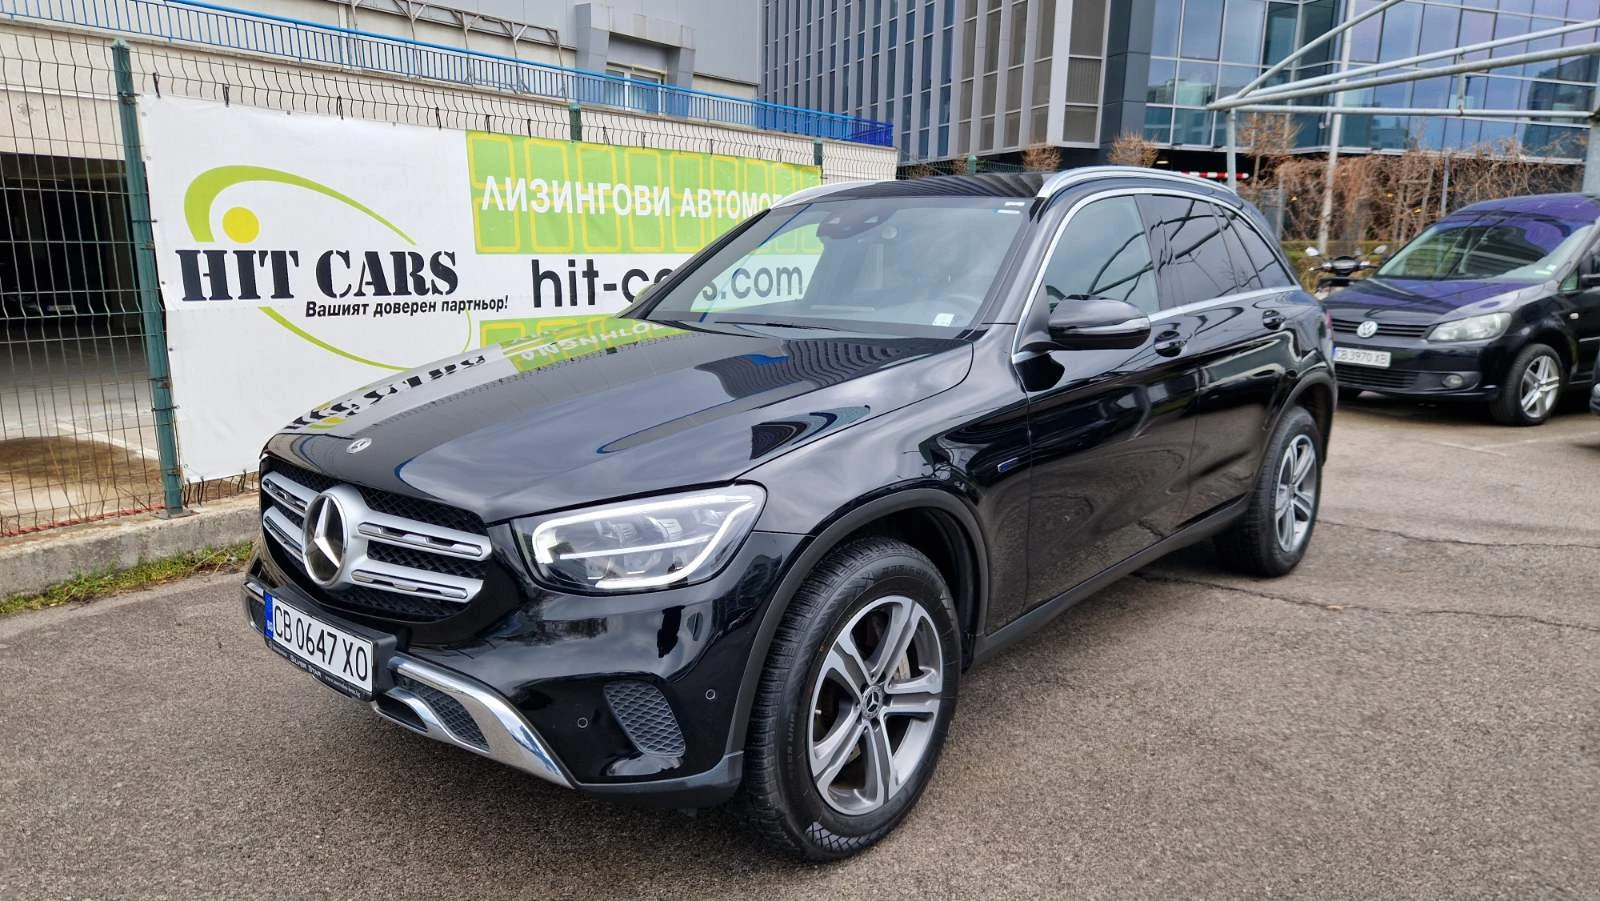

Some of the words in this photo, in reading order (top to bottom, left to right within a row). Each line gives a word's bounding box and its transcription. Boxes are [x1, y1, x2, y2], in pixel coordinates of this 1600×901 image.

[481, 175, 671, 217] ЛИЗИНГОВИ
[680, 187, 784, 220] АВТОМО
[175, 249, 300, 301] HIT
[315, 250, 459, 299] CARS
[531, 258, 804, 308] hit-cs.com
[305, 300, 370, 318] Вашият
[373, 299, 437, 317] доверен
[440, 295, 509, 314] партньор!
[274, 605, 293, 643] CB
[295, 617, 338, 666] 0647
[342, 638, 368, 682] XO
